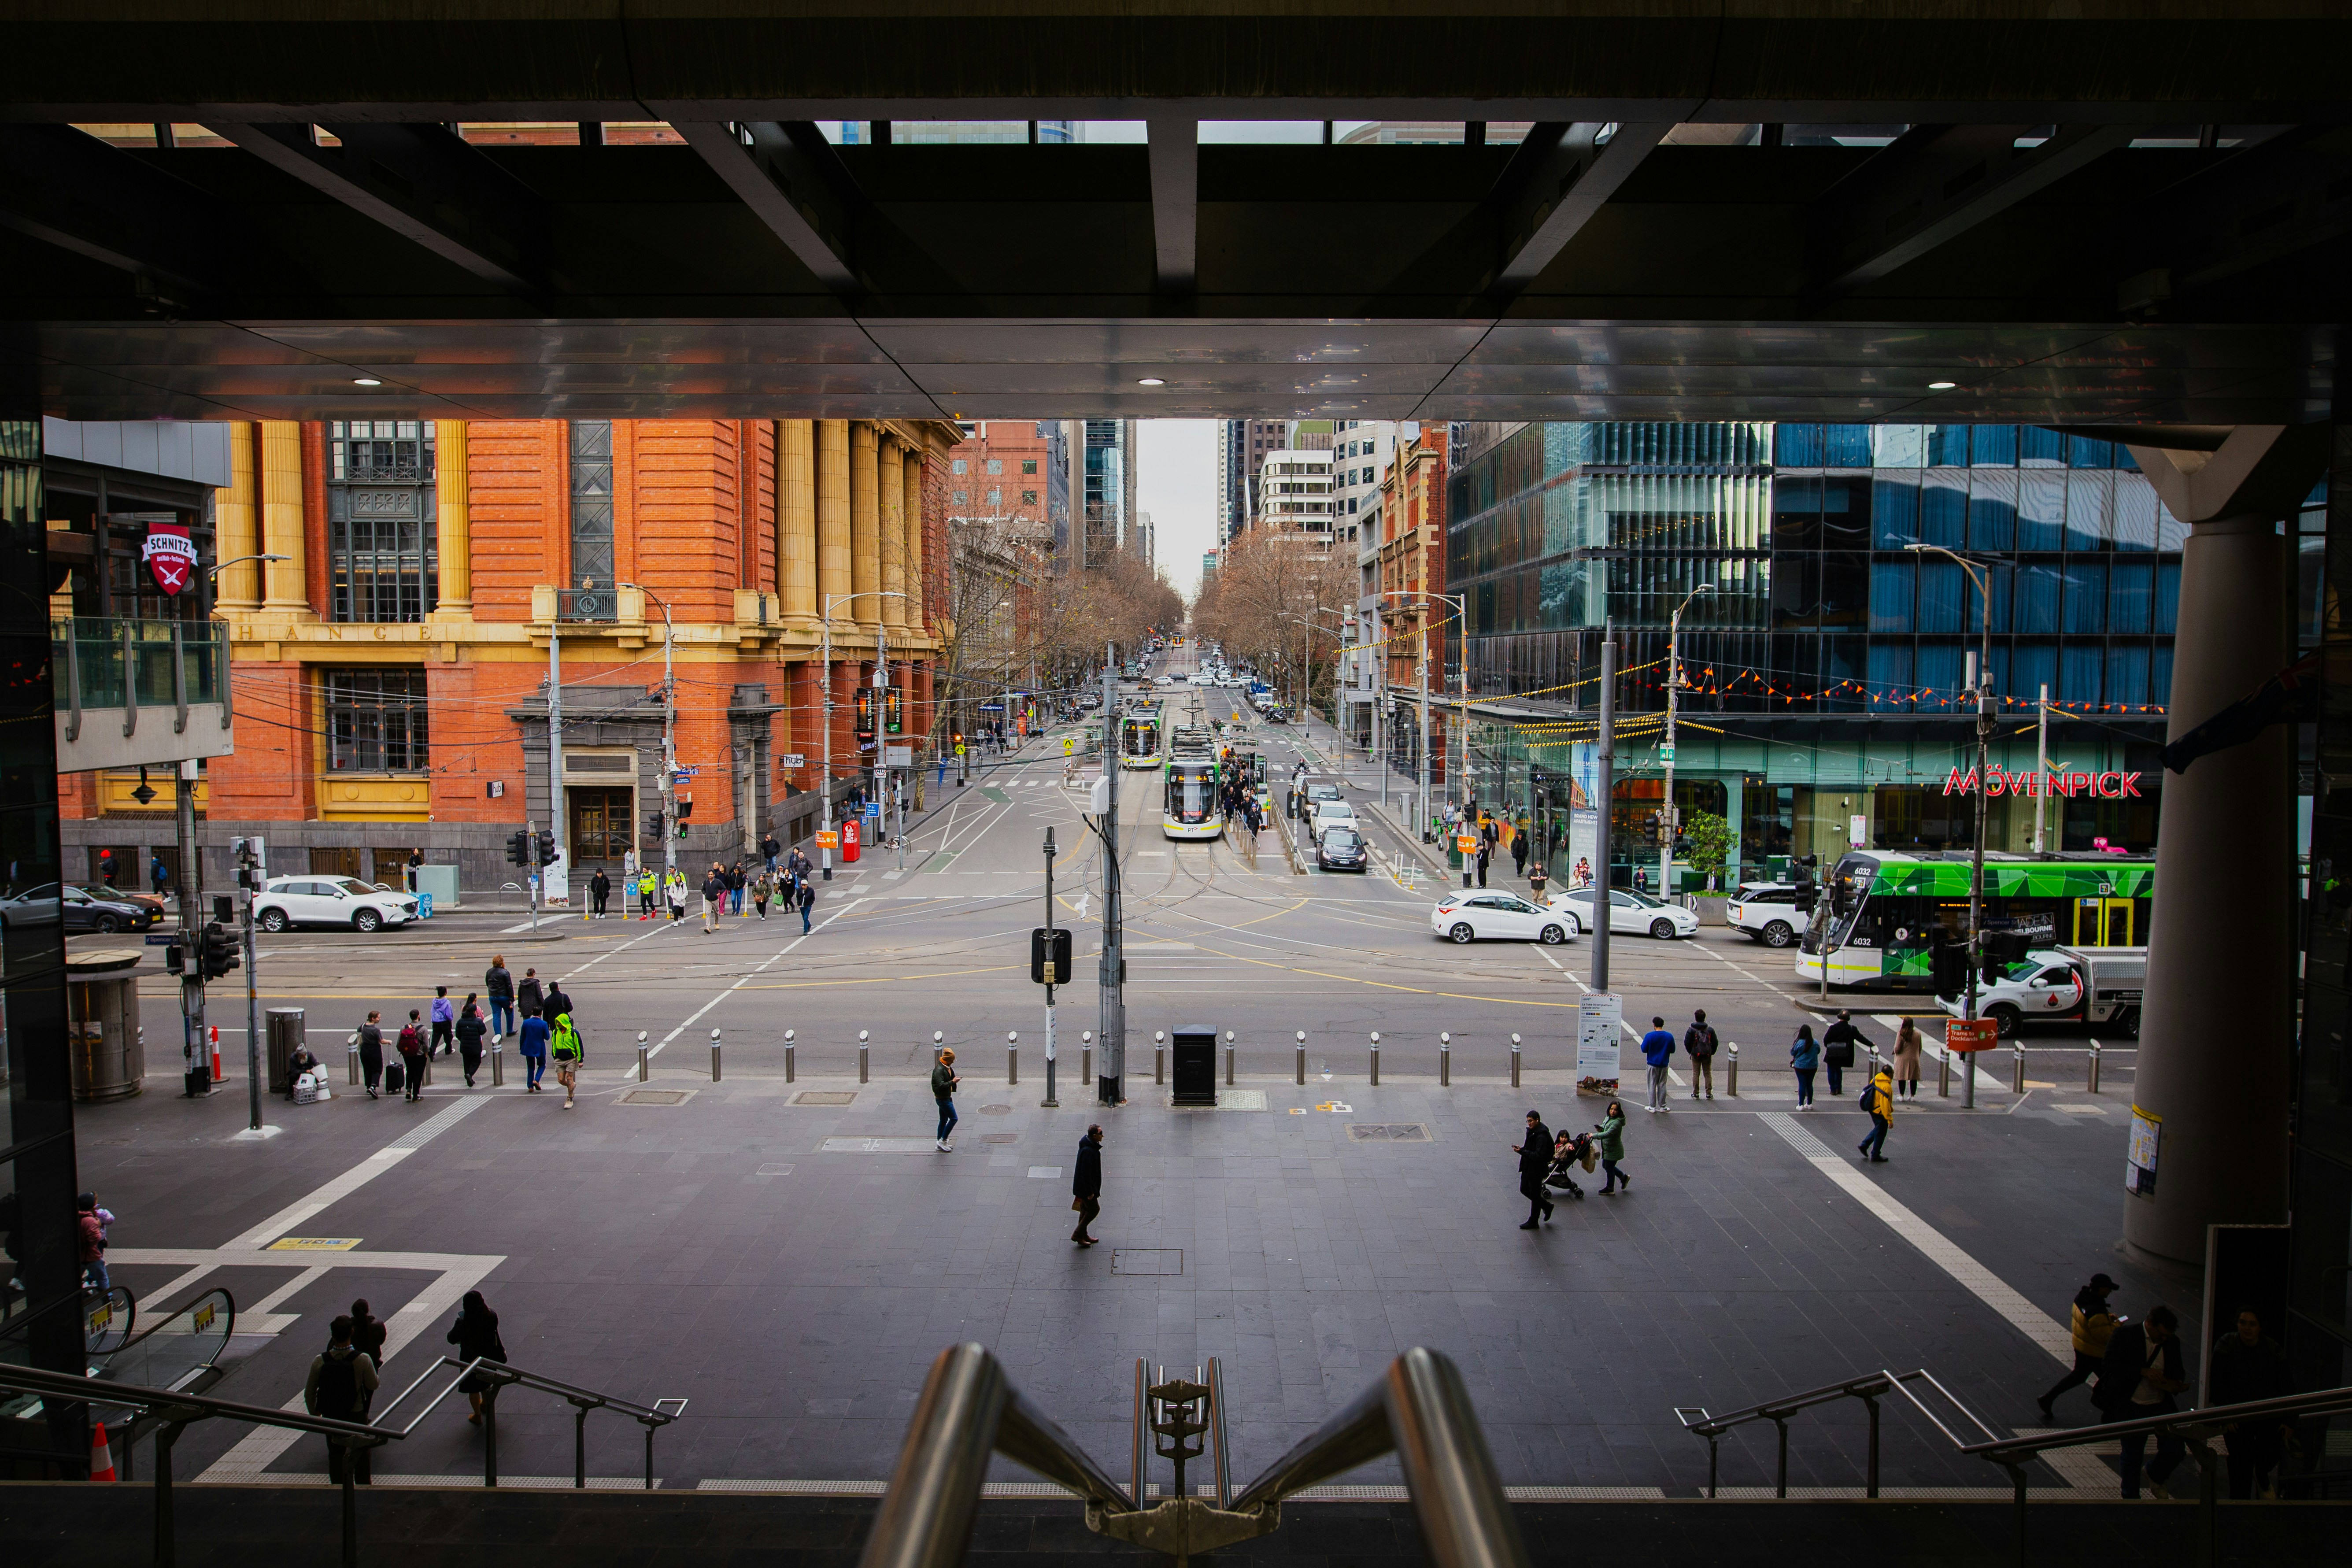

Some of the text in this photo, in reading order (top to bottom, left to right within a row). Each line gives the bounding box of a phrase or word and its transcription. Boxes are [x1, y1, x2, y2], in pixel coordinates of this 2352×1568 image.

[151, 538, 189, 553] SCHNITZ
[785, 755, 802, 764] hub
[1943, 764, 2141, 797] MÖVENPICK
[493, 784, 501, 793] hub
[1854, 867, 1871, 876] 6032
[1853, 937, 1871, 946] 6032
